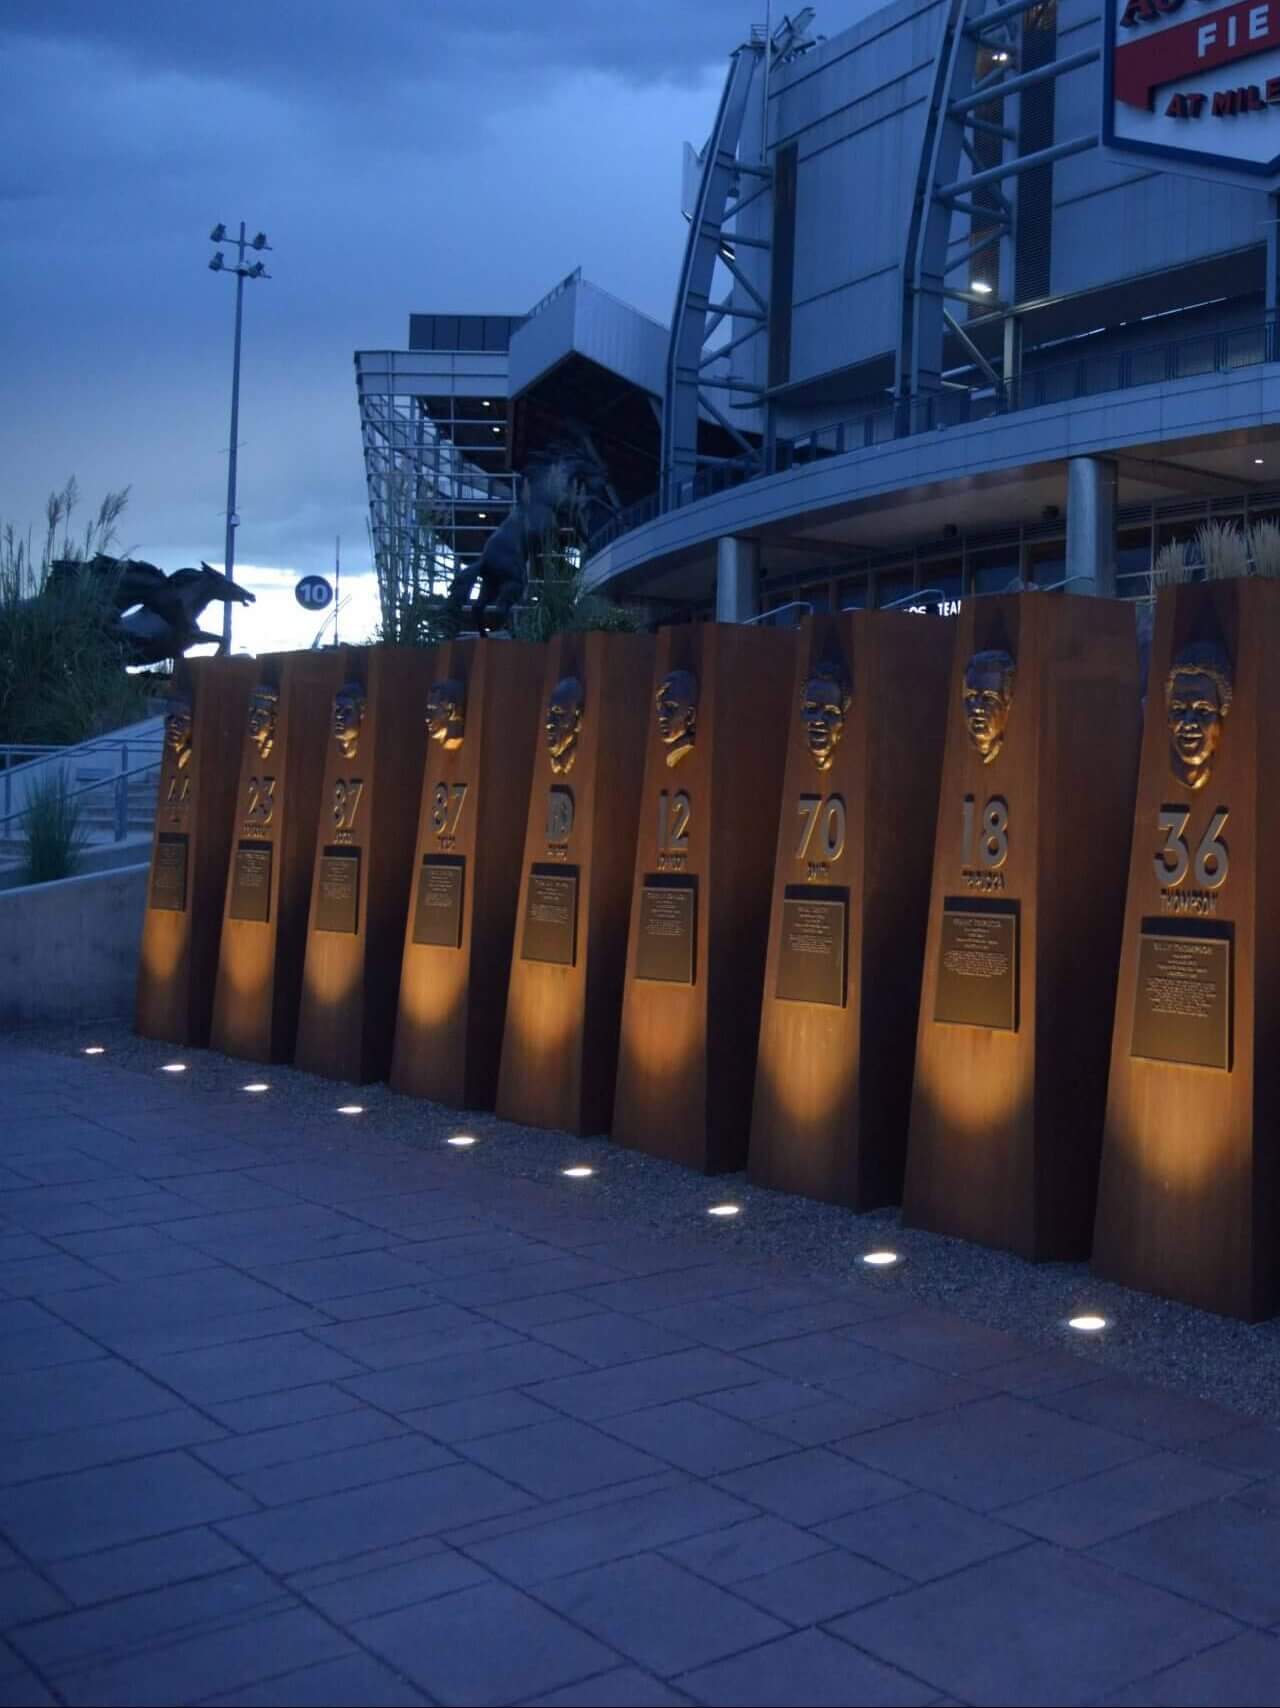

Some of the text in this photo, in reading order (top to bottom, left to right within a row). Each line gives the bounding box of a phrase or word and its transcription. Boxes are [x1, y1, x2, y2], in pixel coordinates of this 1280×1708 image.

[1165, 93, 1207, 118] AT
[300, 583, 329, 603] 10
[431, 784, 469, 835] 87
[656, 794, 691, 851] 12
[796, 799, 847, 862] 70
[961, 799, 1009, 869] 18
[1153, 811, 1231, 889] 36
